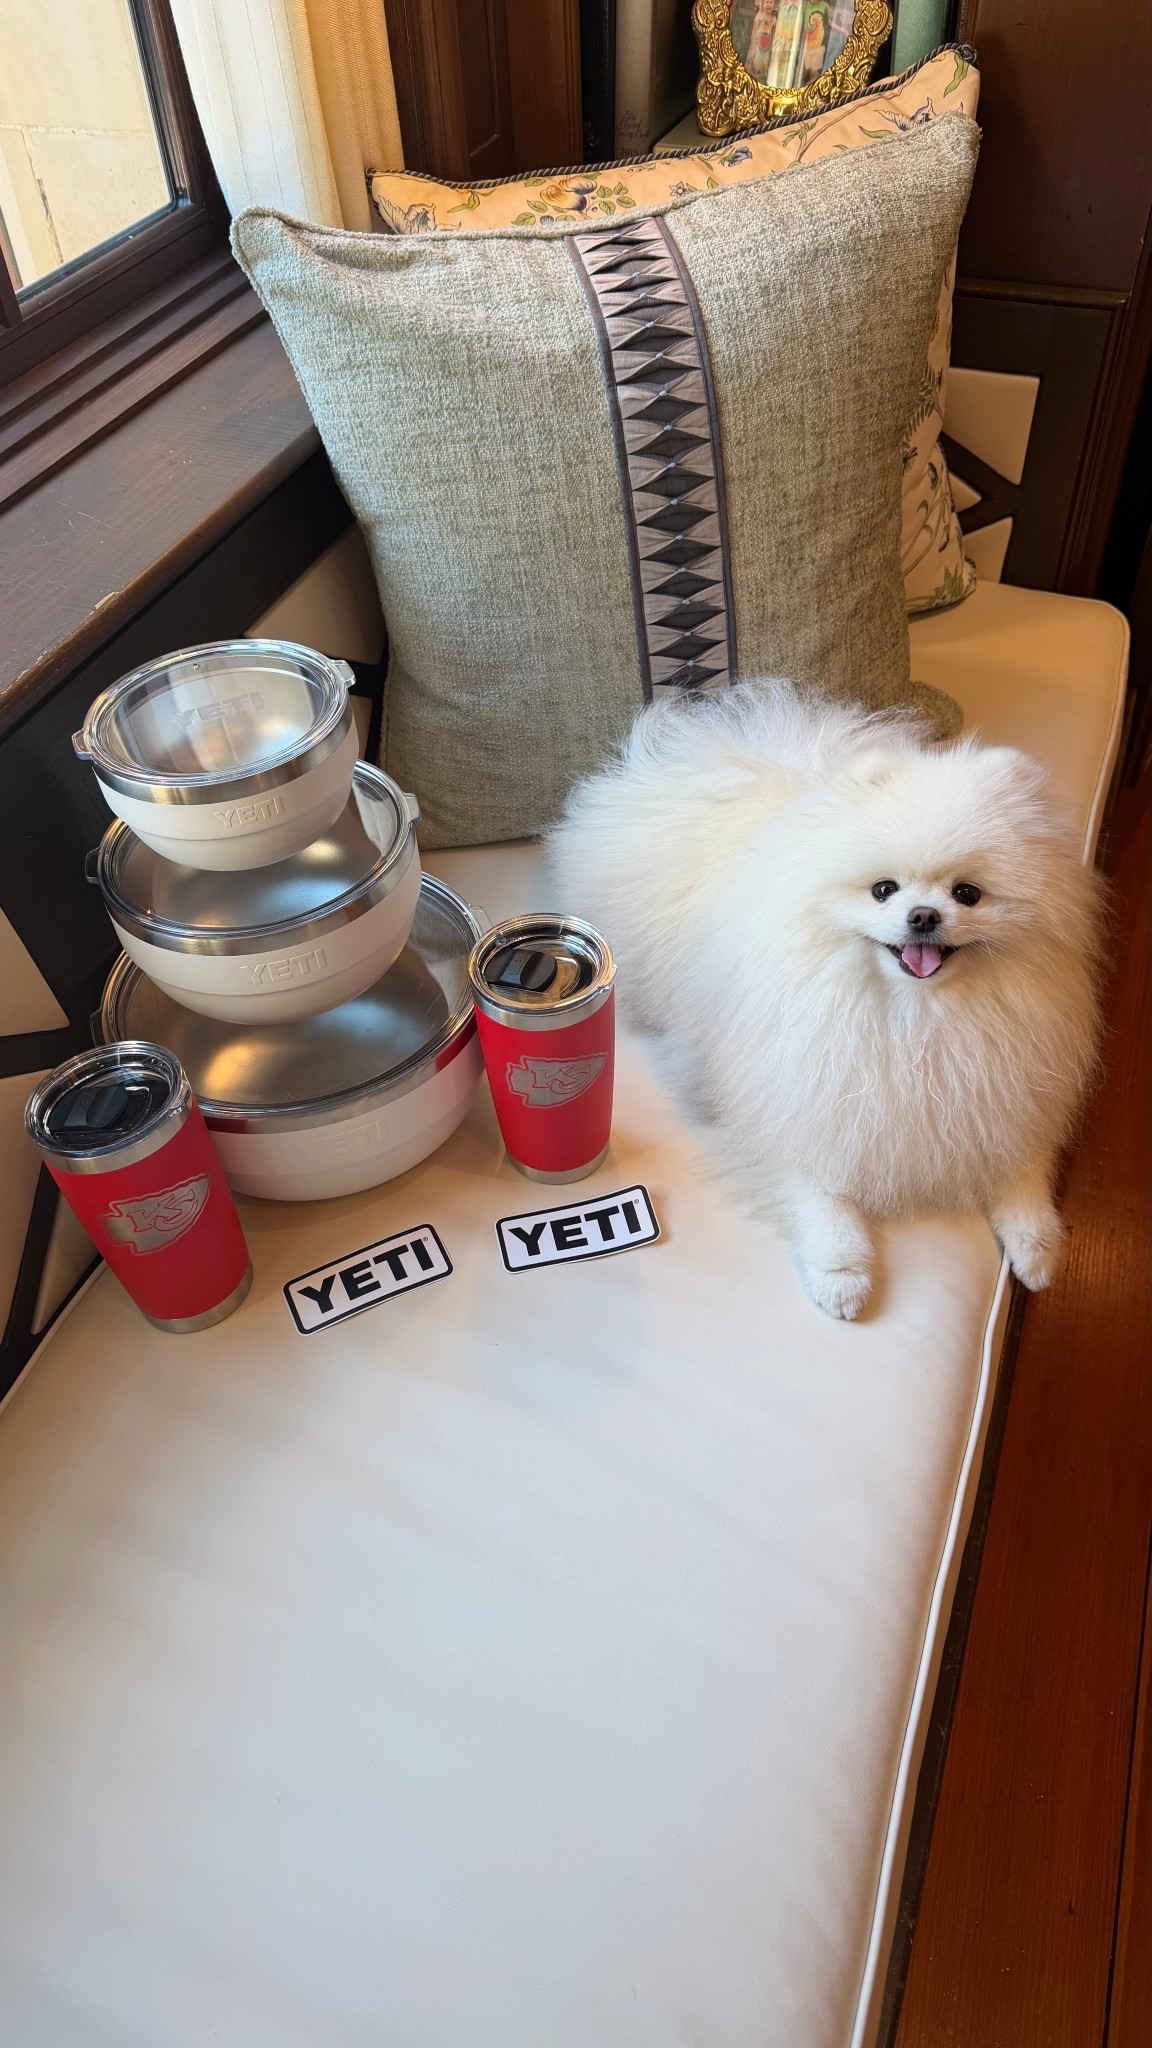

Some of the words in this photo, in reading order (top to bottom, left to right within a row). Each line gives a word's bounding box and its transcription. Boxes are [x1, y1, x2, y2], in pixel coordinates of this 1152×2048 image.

[170, 691, 267, 732] YETI
[213, 796, 286, 829] YETI
[239, 948, 328, 985] YETI
